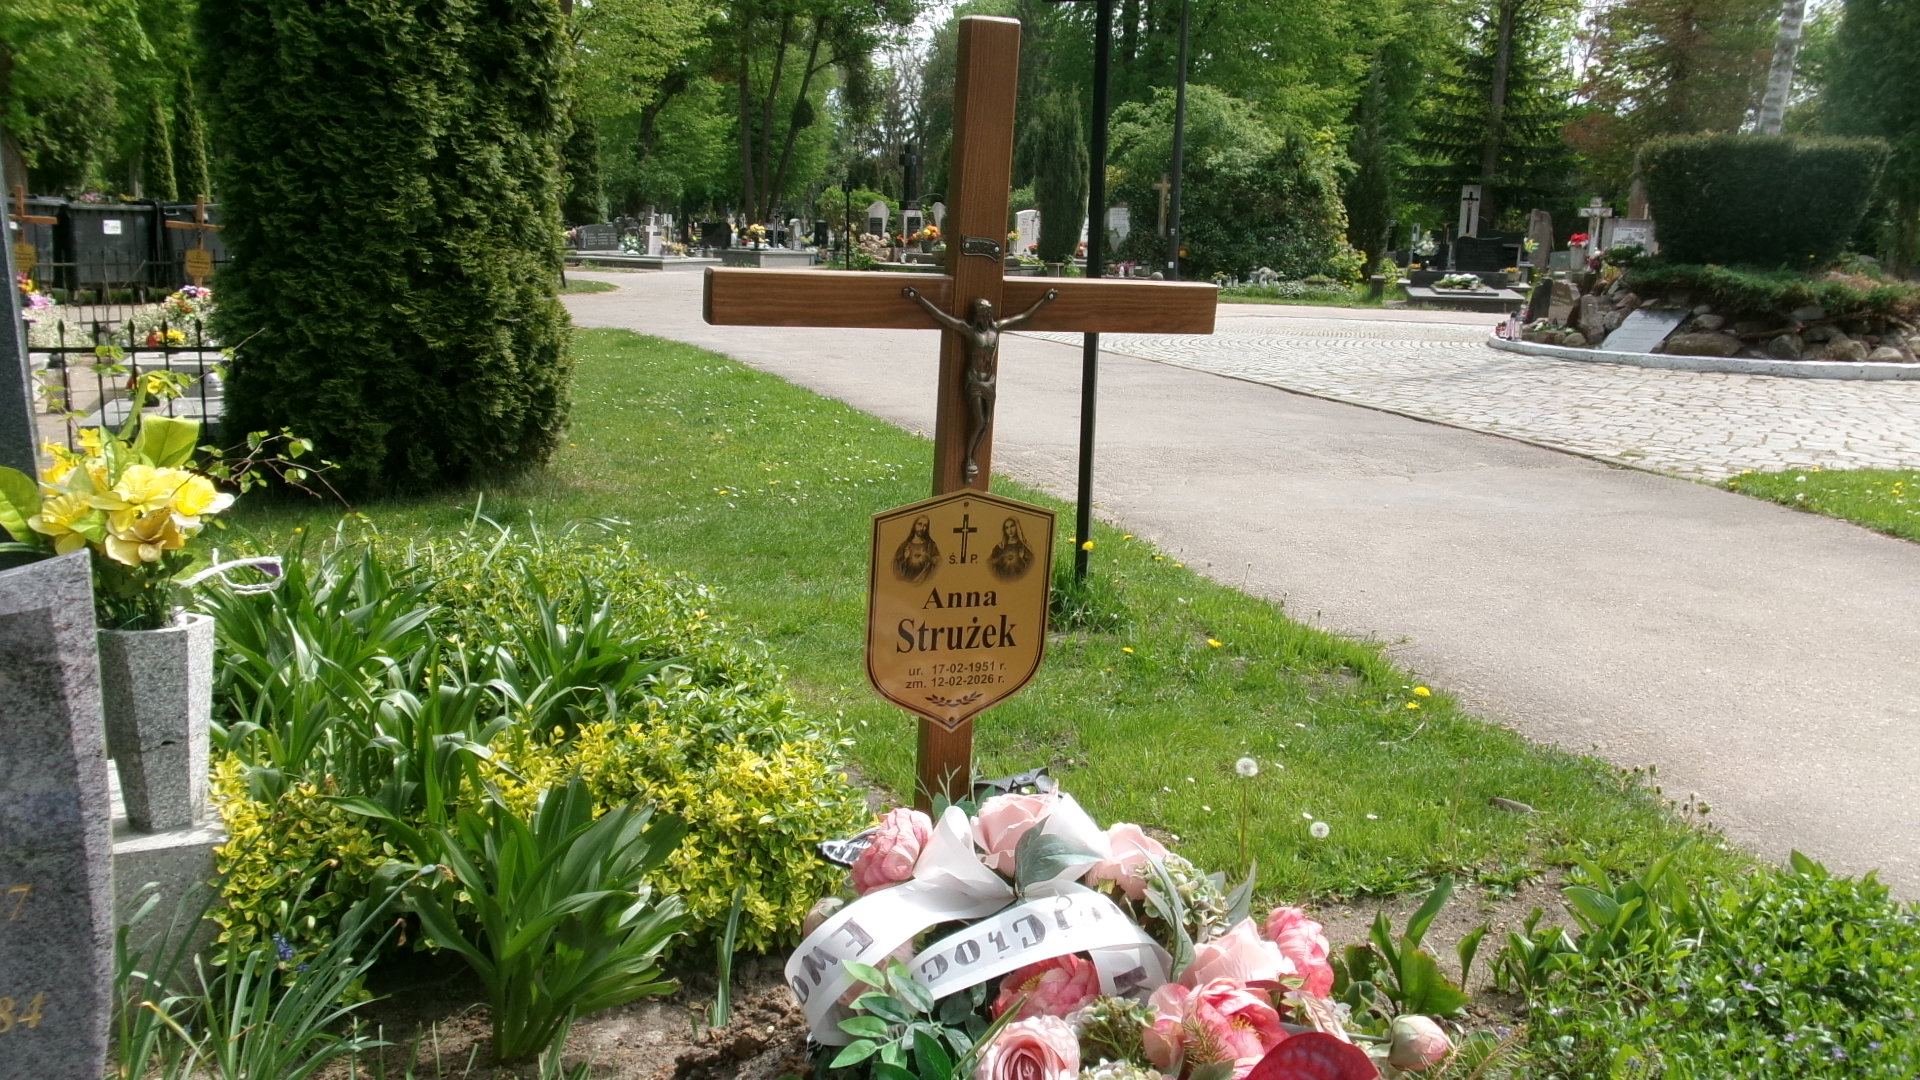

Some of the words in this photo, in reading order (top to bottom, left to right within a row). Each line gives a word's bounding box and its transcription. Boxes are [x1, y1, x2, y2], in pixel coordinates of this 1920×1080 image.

[970, 553, 978, 564] P.
[922, 587, 997, 610] Anna
[896, 615, 1017, 654] Strużek
[908, 667, 924, 676] ur.
[932, 661, 995, 674] 17-02-1951
[999, 662, 1007, 671] r.
[905, 680, 926, 689] zm.
[931, 674, 994, 687] 12-02-2026
[998, 675, 1005, 683] r.
[0, 883, 34, 922] 7
